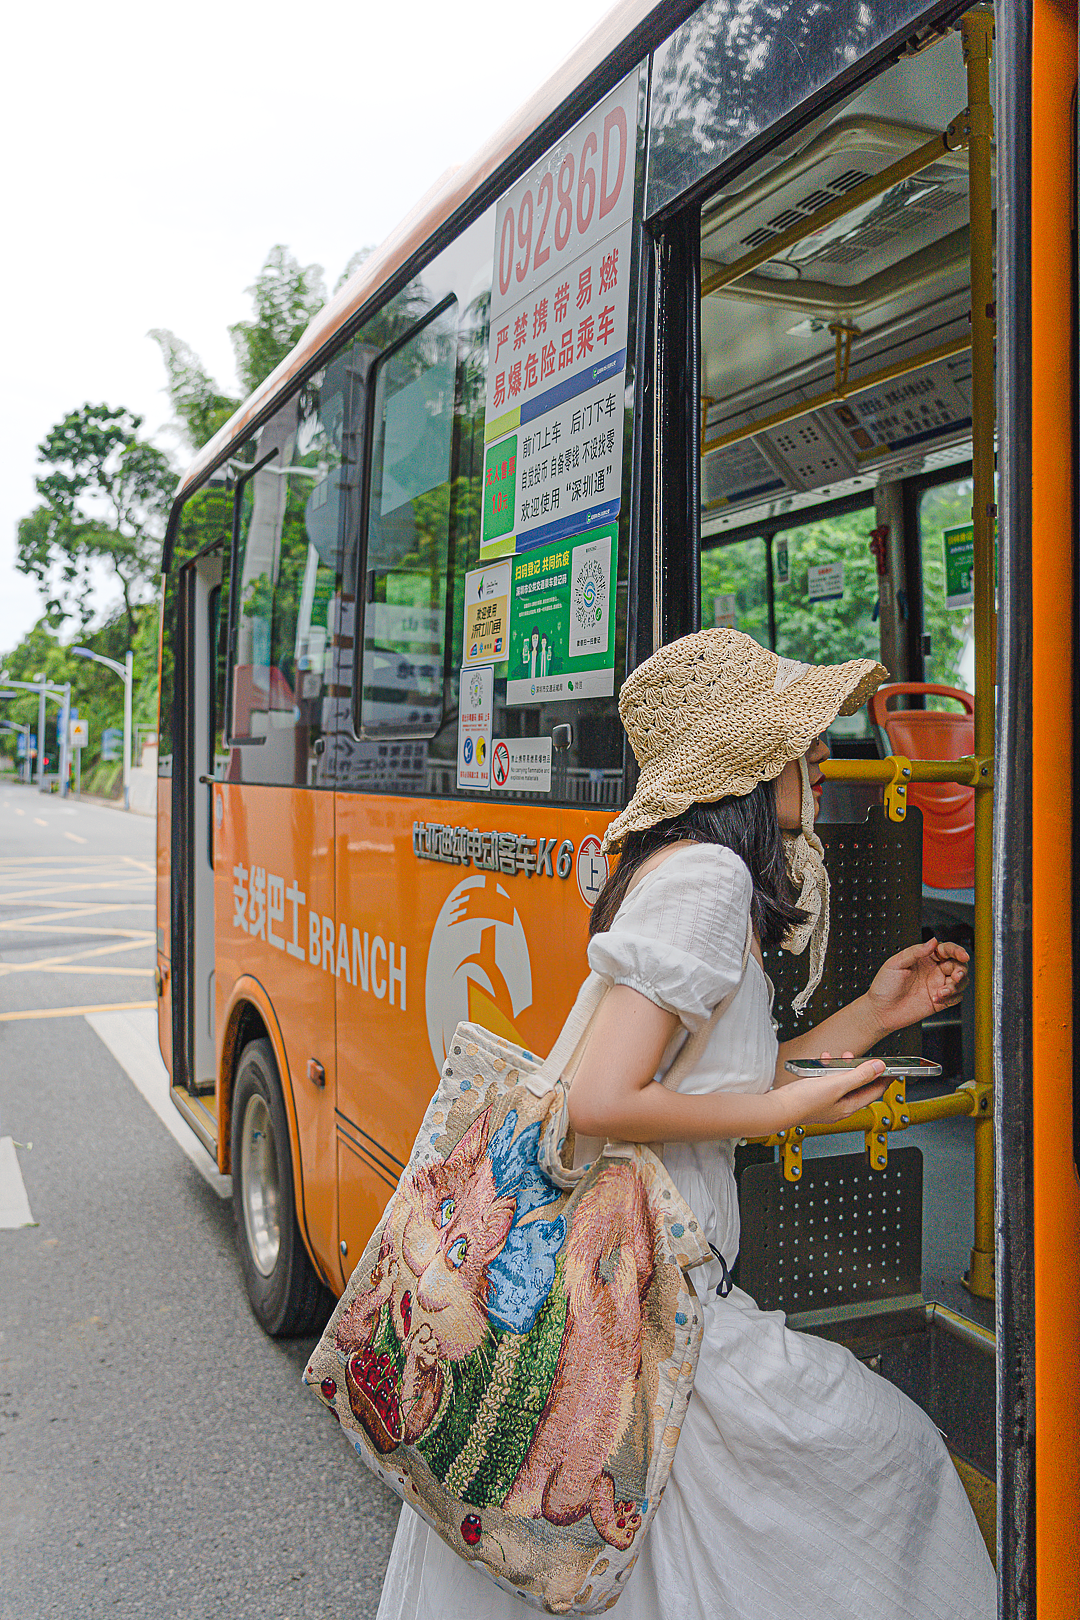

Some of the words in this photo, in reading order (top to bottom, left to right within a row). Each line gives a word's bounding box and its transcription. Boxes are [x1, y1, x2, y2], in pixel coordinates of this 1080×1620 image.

[500, 106, 628, 296] 09286D
[495, 248, 619, 364] 严禁携带易燃
[493, 305, 616, 408] 易爆危险品乘车
[523, 421, 562, 459] 前门上车
[570, 393, 616, 434] 后门下车
[485, 456, 516, 487] 无人售票
[521, 460, 548, 491] 自觉投币
[551, 445, 580, 478] 自备零钱
[582, 429, 615, 463] 不设找零
[521, 488, 560, 521] 欢迎使用
[514, 559, 541, 580] 扫码登记
[541, 550, 570, 572] 共同抗疫
[308, 910, 407, 1011] BRANCH
